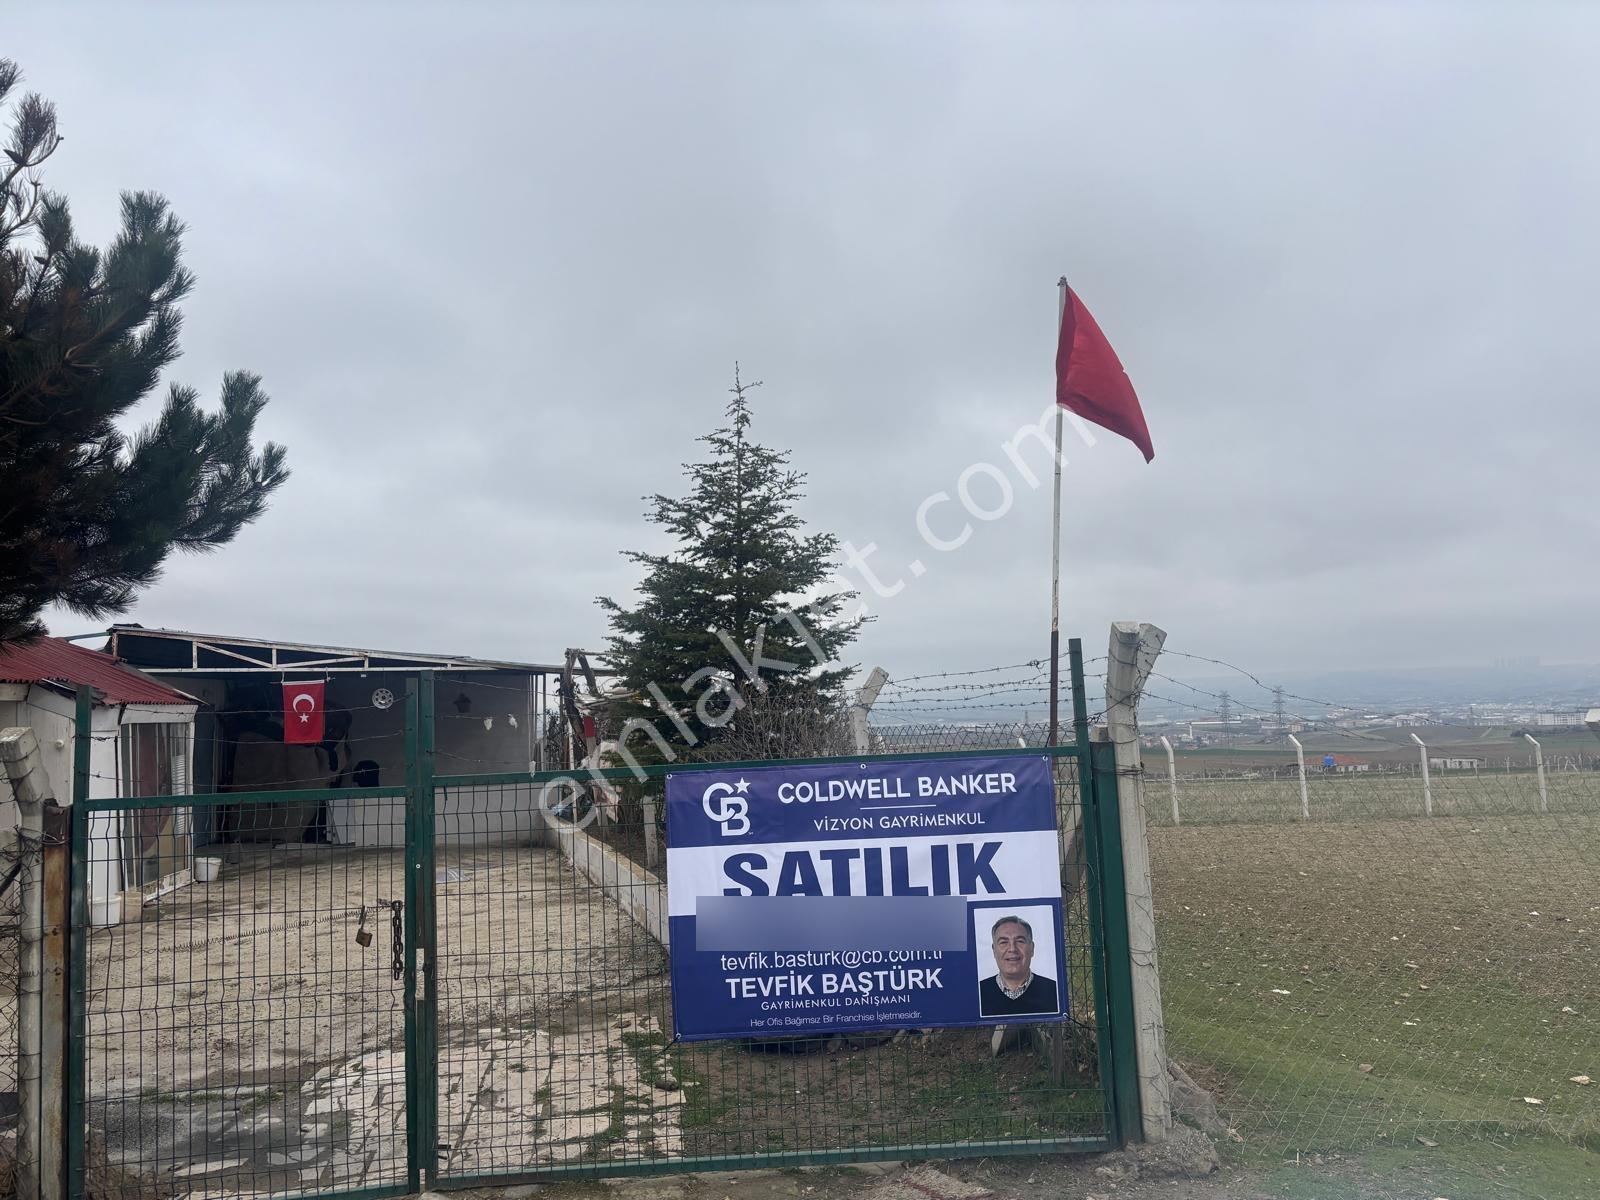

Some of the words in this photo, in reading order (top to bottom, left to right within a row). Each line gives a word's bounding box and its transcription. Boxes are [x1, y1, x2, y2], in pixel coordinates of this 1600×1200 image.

[777, 777, 911, 804] COLDWELL
[917, 772, 1018, 797] BANKER
[813, 815, 873, 832] VİZYON
[879, 812, 986, 829] GAYRİMENKUL
[722, 841, 1007, 897] SATILIK
[725, 969, 815, 999] TEVFİK
[822, 965, 944, 997] BAŞTÜRK
[760, 998, 841, 1011] GAYRİMENKUL
[845, 994, 911, 1007] DANIŞMANI
[750, 1018, 765, 1028] Her
[766, 1017, 783, 1027] Ofis
[823, 1014, 835, 1024] Bir
[836, 1012, 875, 1023] Franchise
